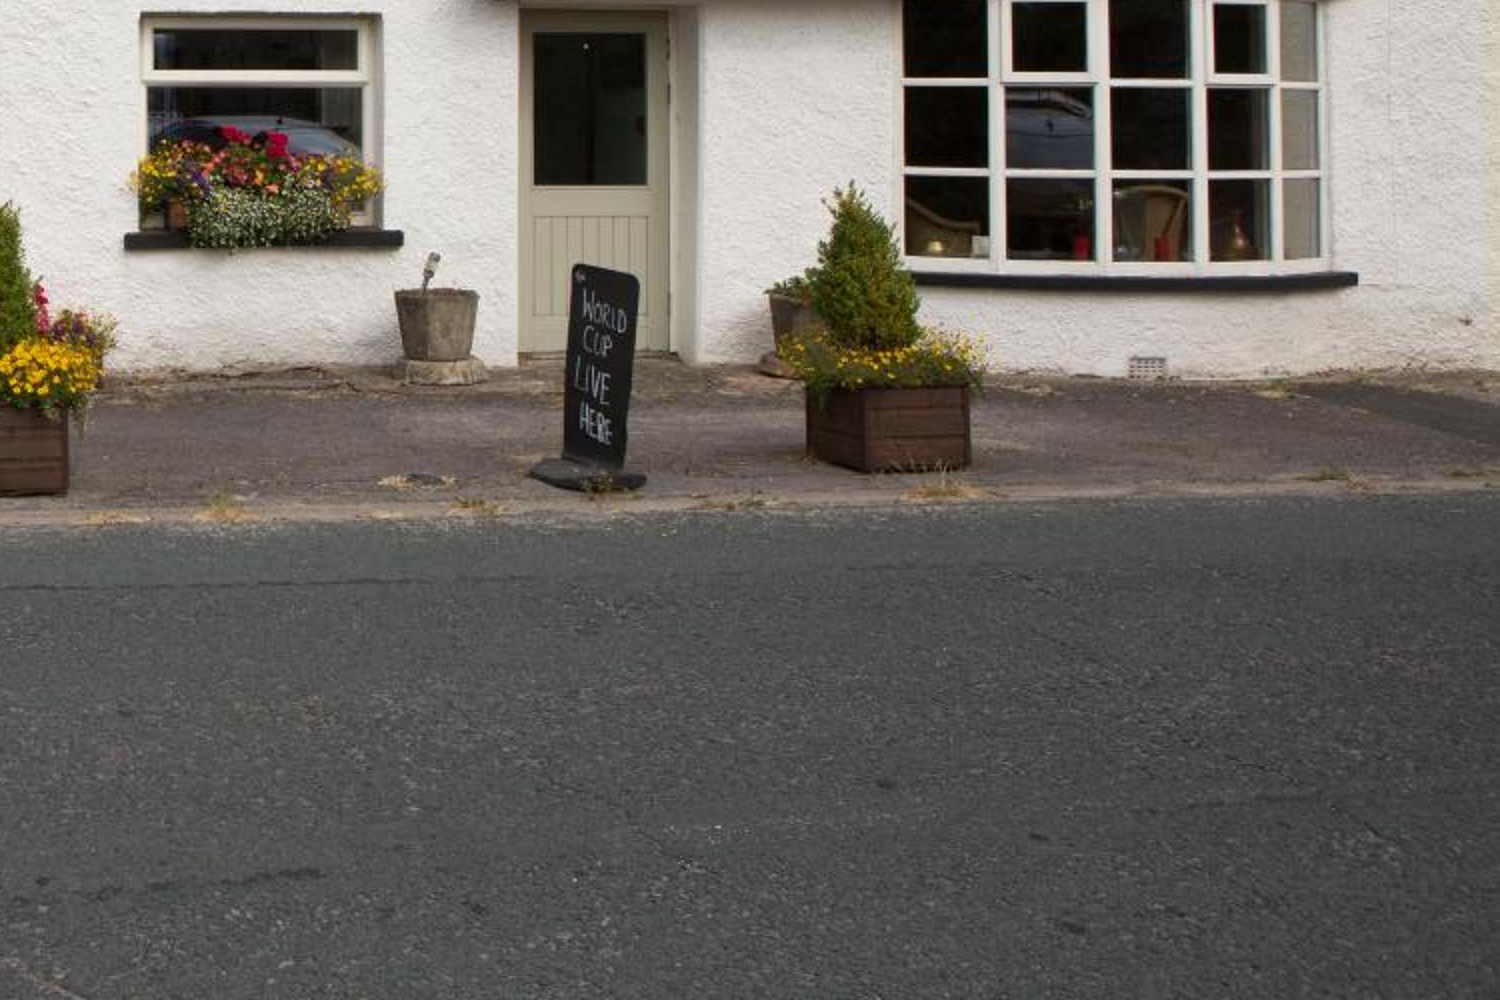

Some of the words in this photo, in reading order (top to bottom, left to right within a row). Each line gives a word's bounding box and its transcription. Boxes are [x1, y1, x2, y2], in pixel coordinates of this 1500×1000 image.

[582, 288, 627, 334] WORLD
[582, 325, 613, 357] CUP
[573, 354, 612, 405] LIVE
[579, 401, 612, 445] HERE
